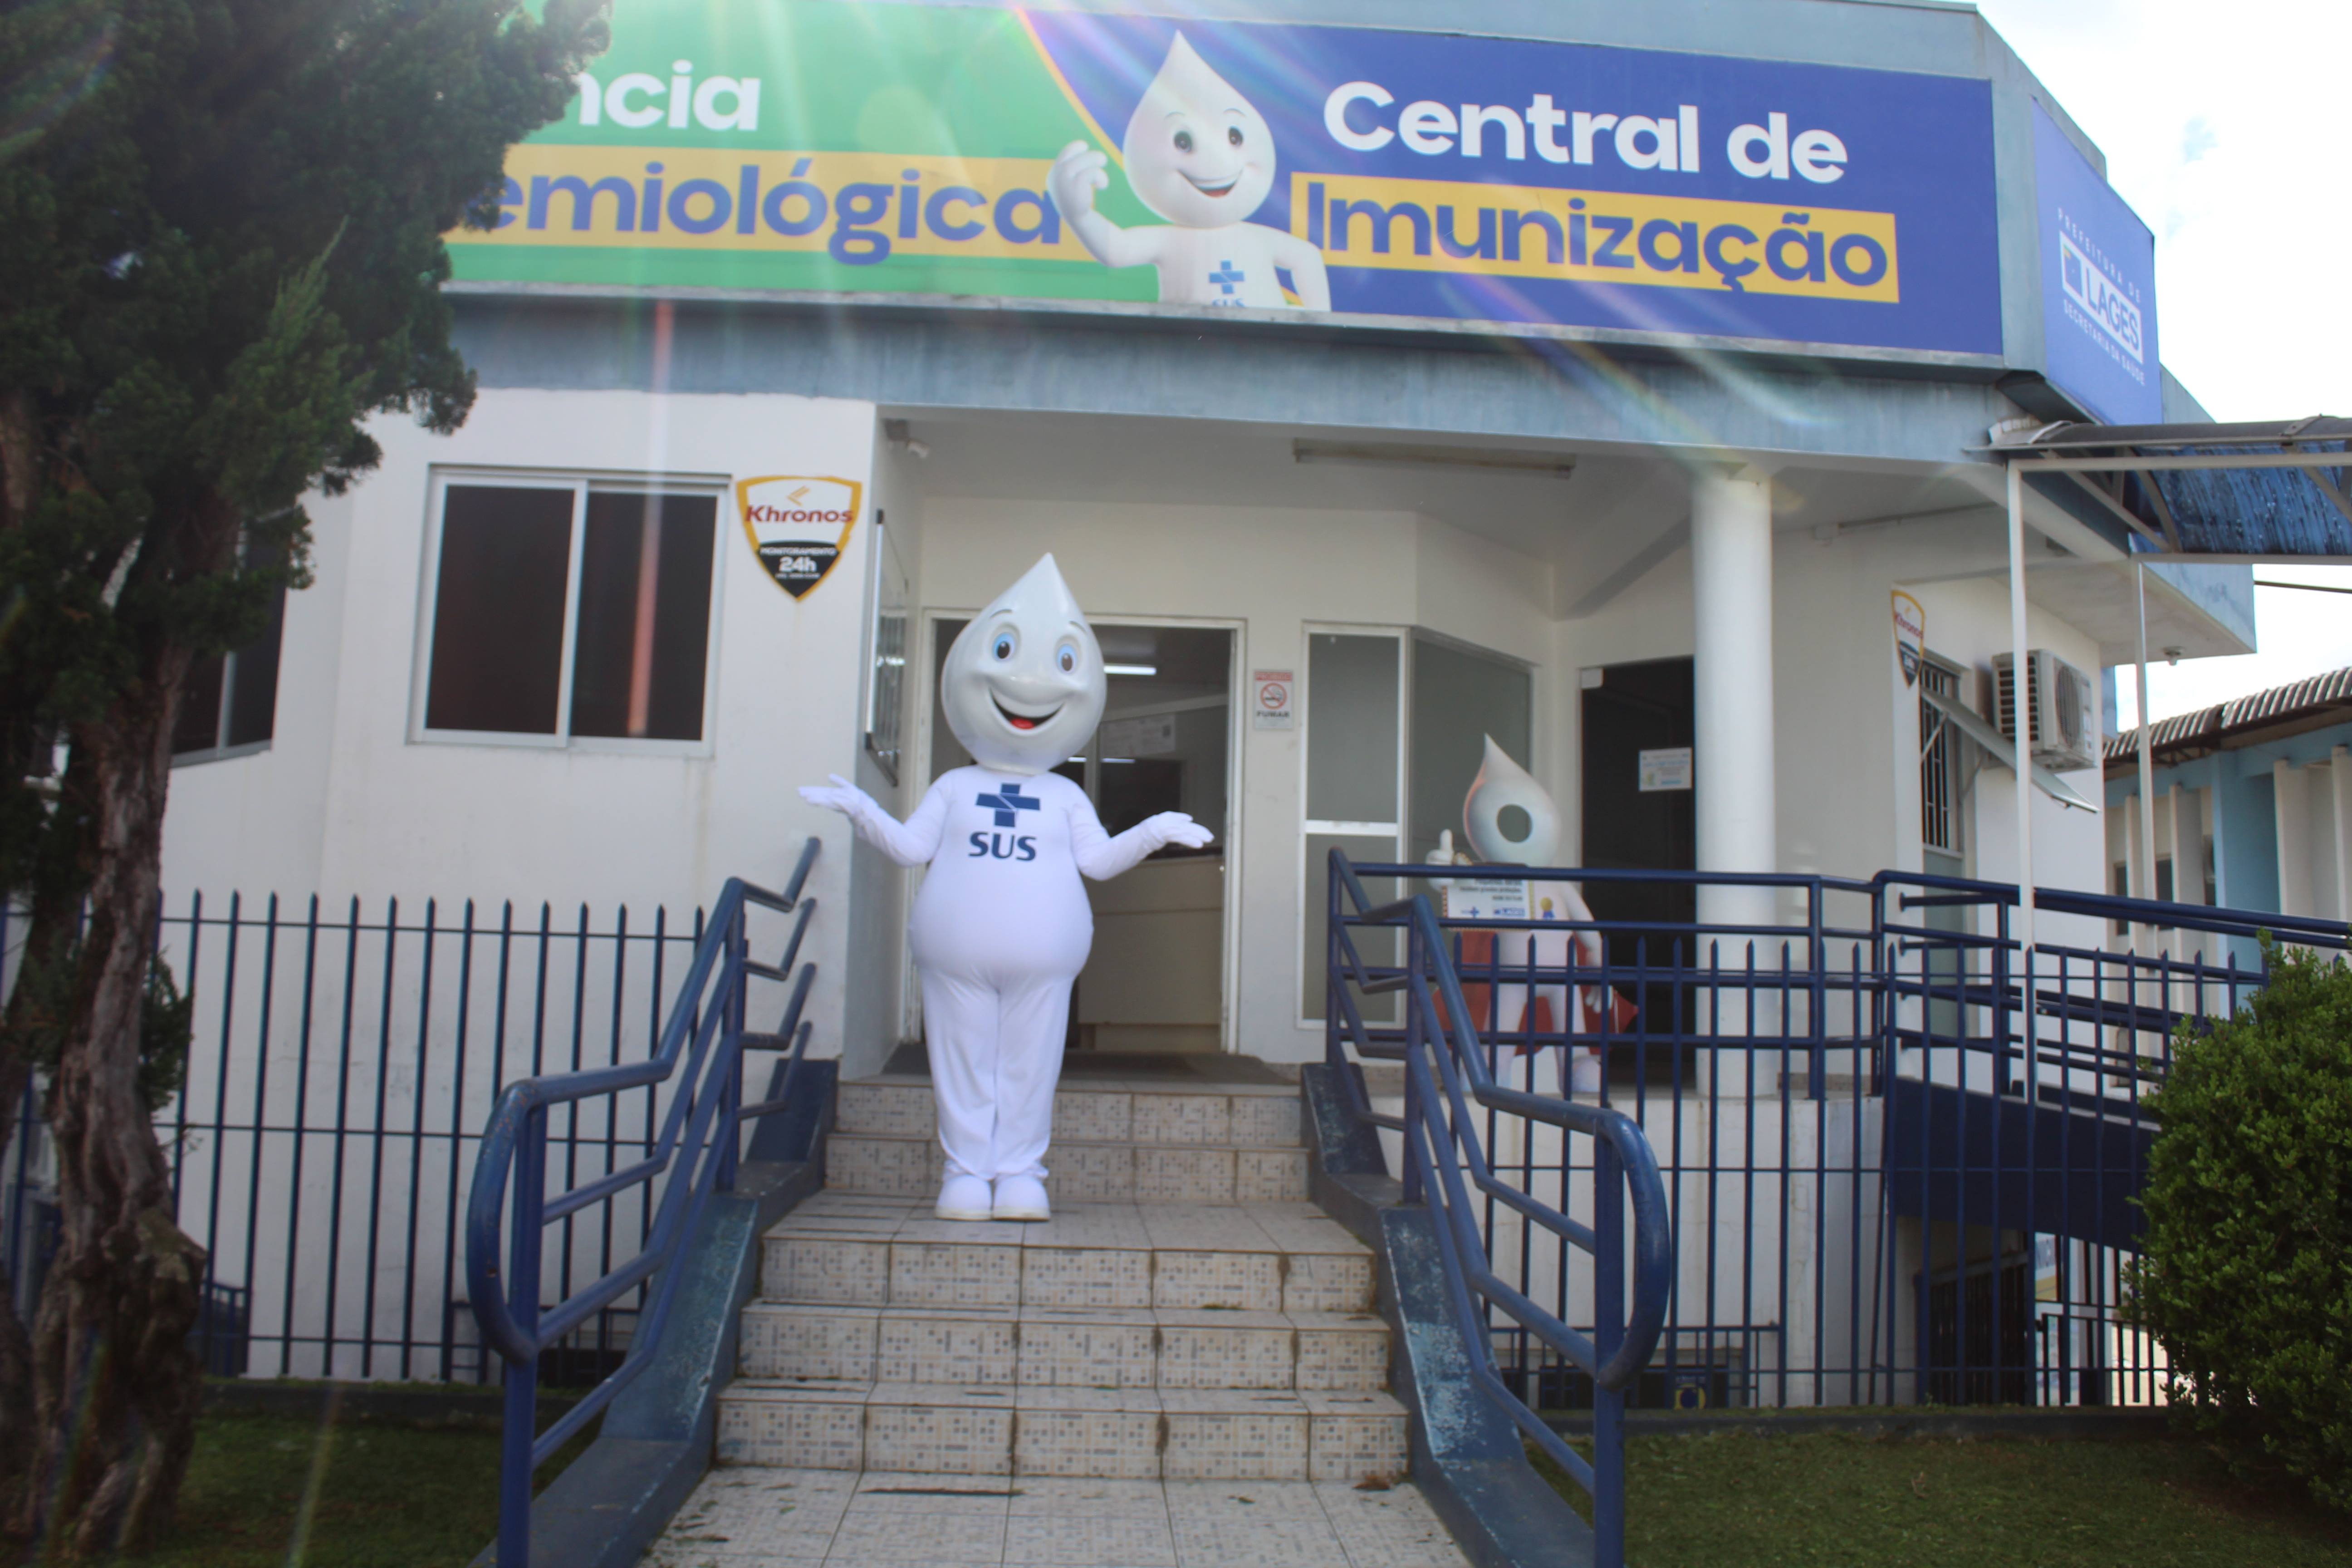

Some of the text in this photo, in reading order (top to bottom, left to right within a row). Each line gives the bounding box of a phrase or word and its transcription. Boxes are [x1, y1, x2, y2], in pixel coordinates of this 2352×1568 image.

[1323, 81, 1848, 184] Central de
[1305, 181, 1889, 293] Imunização
[2058, 207, 2140, 303] PREFEITURA DE
[2086, 266, 2141, 352] LAGES
[745, 504, 854, 523] Khronos
[779, 556, 817, 573] 24h
[968, 831, 1038, 862] SUS
